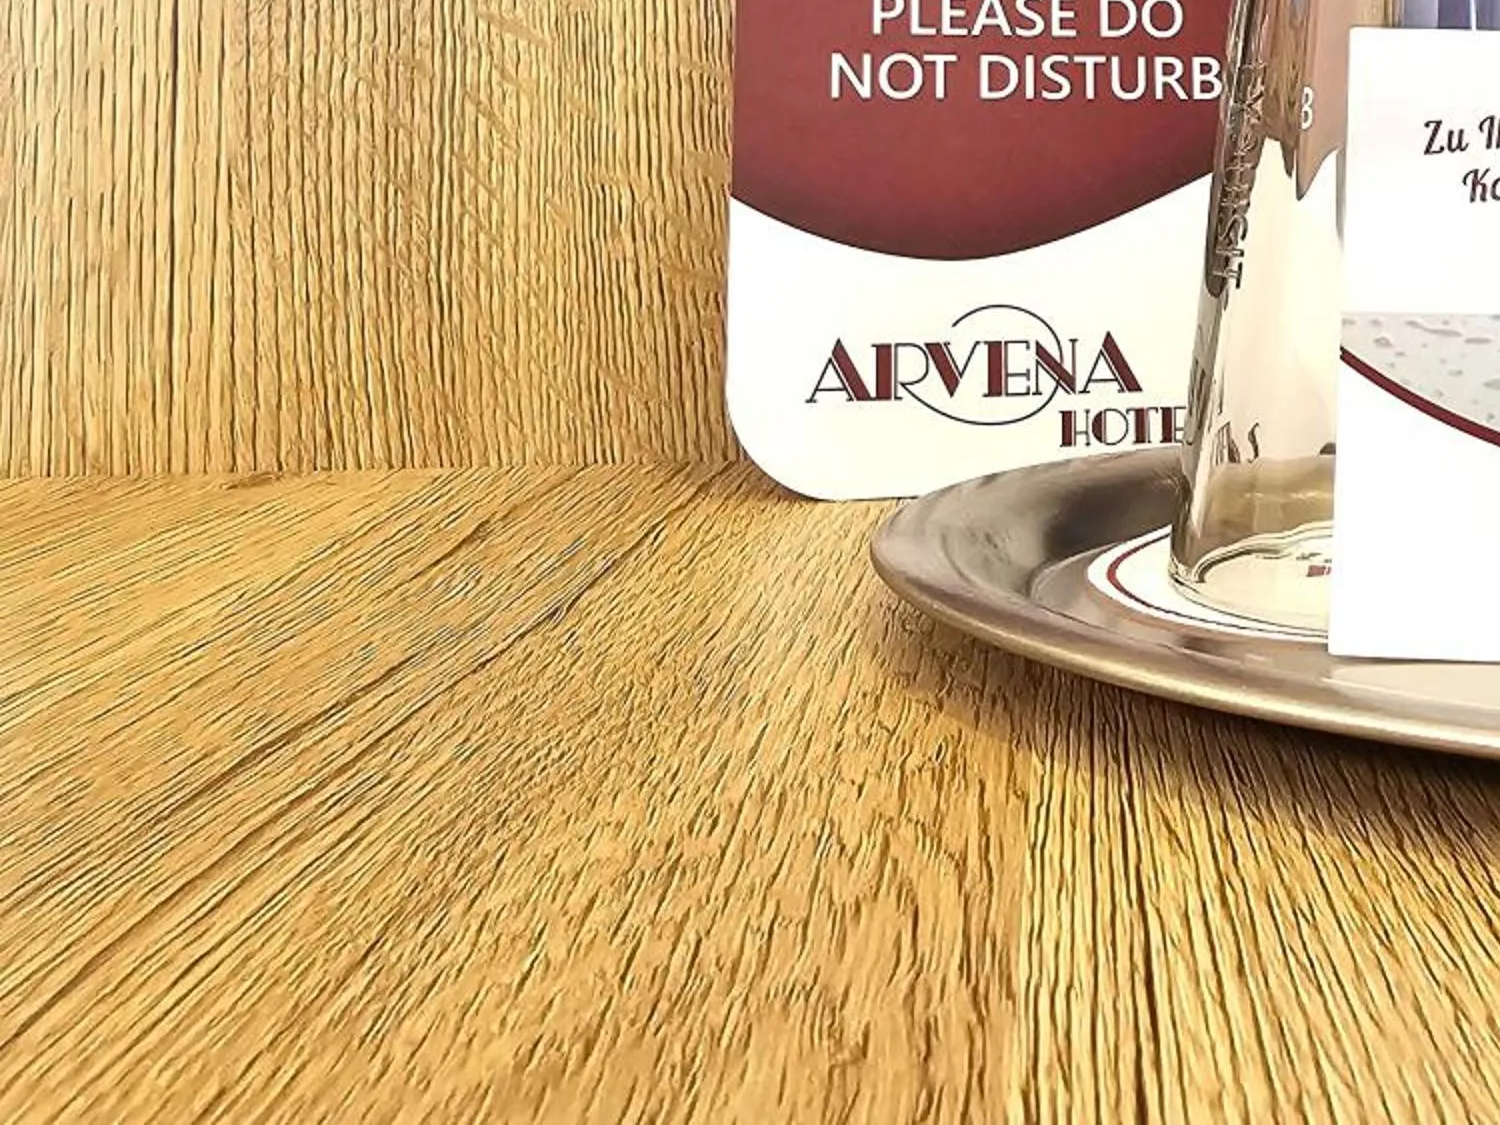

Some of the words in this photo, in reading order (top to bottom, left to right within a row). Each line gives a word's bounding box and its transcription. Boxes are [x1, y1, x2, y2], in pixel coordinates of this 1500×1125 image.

[830, 52, 957, 100] NOT
[979, 54, 1223, 102] DISTURB
[1423, 120, 1469, 156] Zu
[805, 330, 1143, 404] ARVENA
